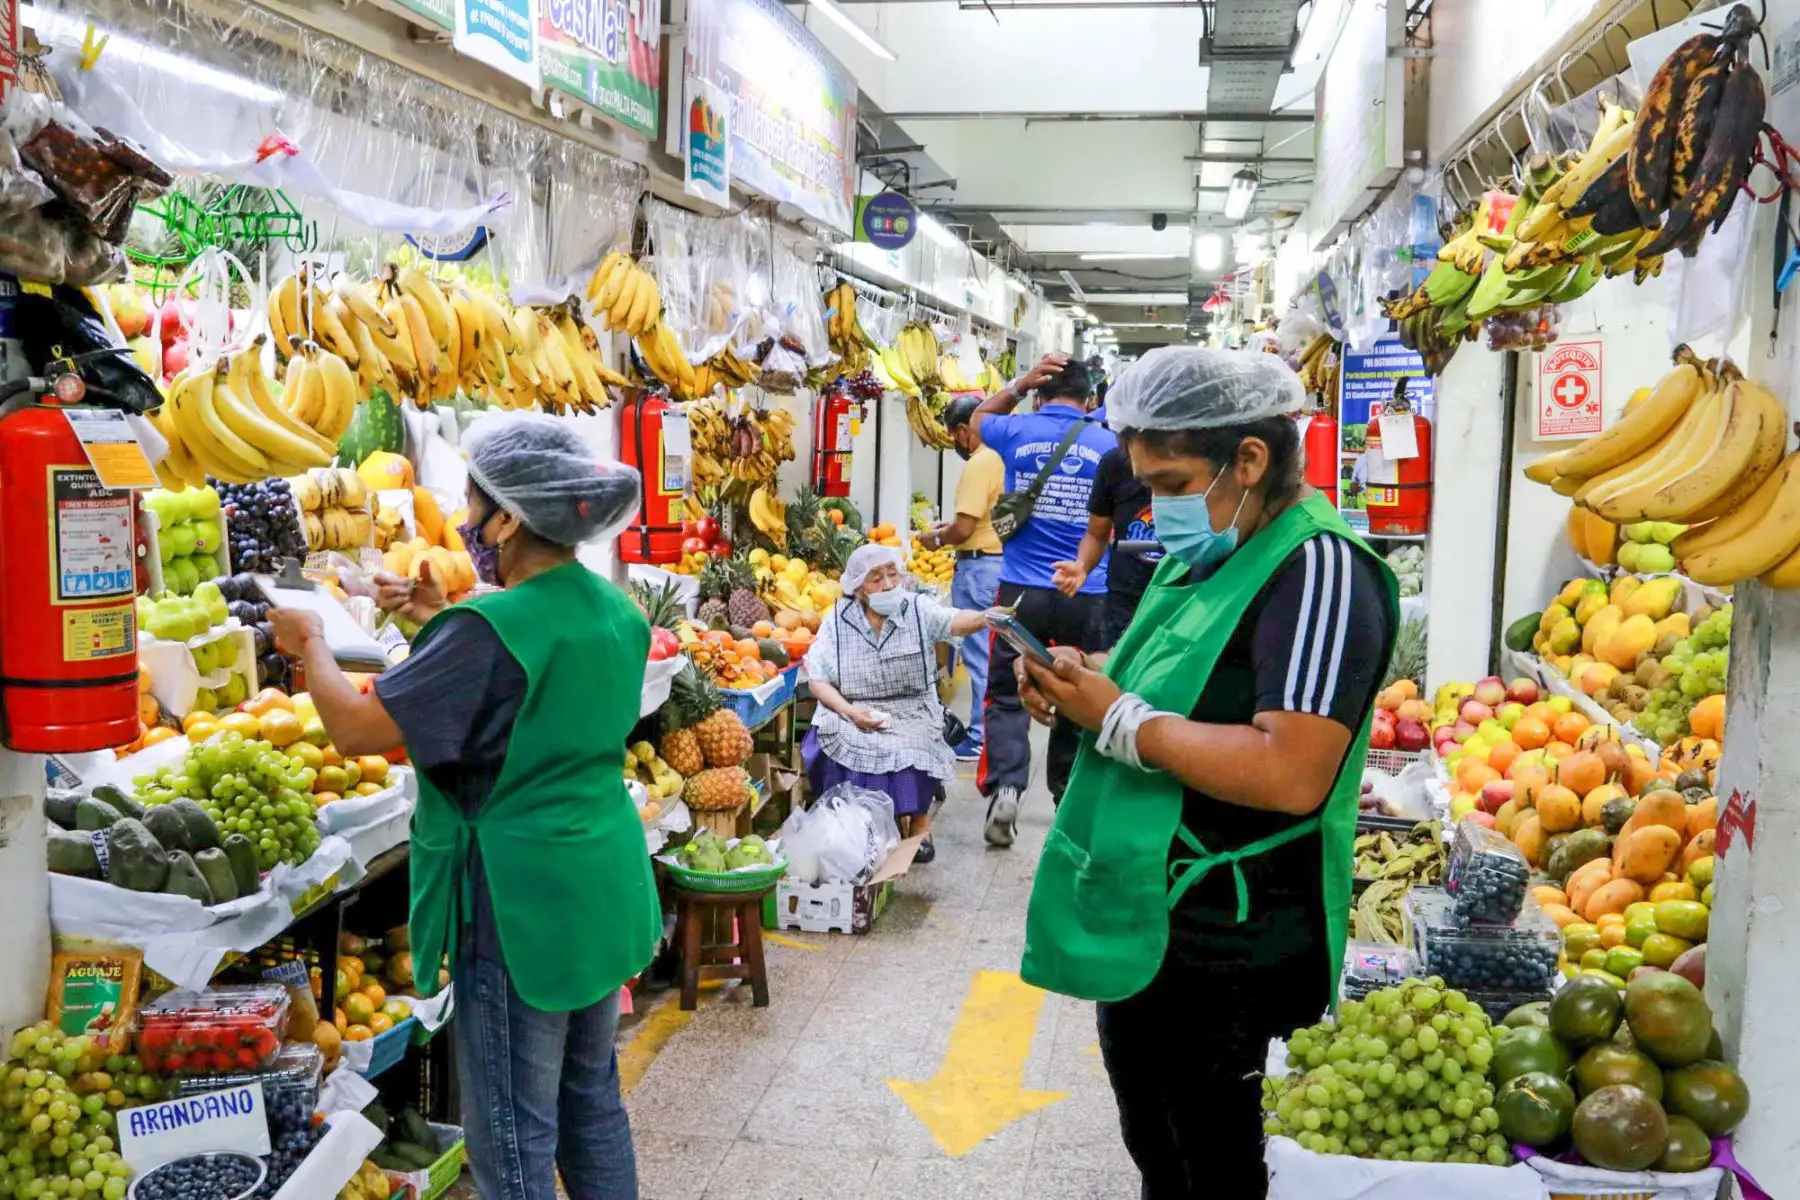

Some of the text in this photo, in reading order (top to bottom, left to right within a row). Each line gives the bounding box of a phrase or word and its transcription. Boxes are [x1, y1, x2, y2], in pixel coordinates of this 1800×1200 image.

[57, 474, 98, 482] EXTINTO
[67, 966, 122, 978] AGUAJE
[130, 1089, 254, 1137] ARANDANO
